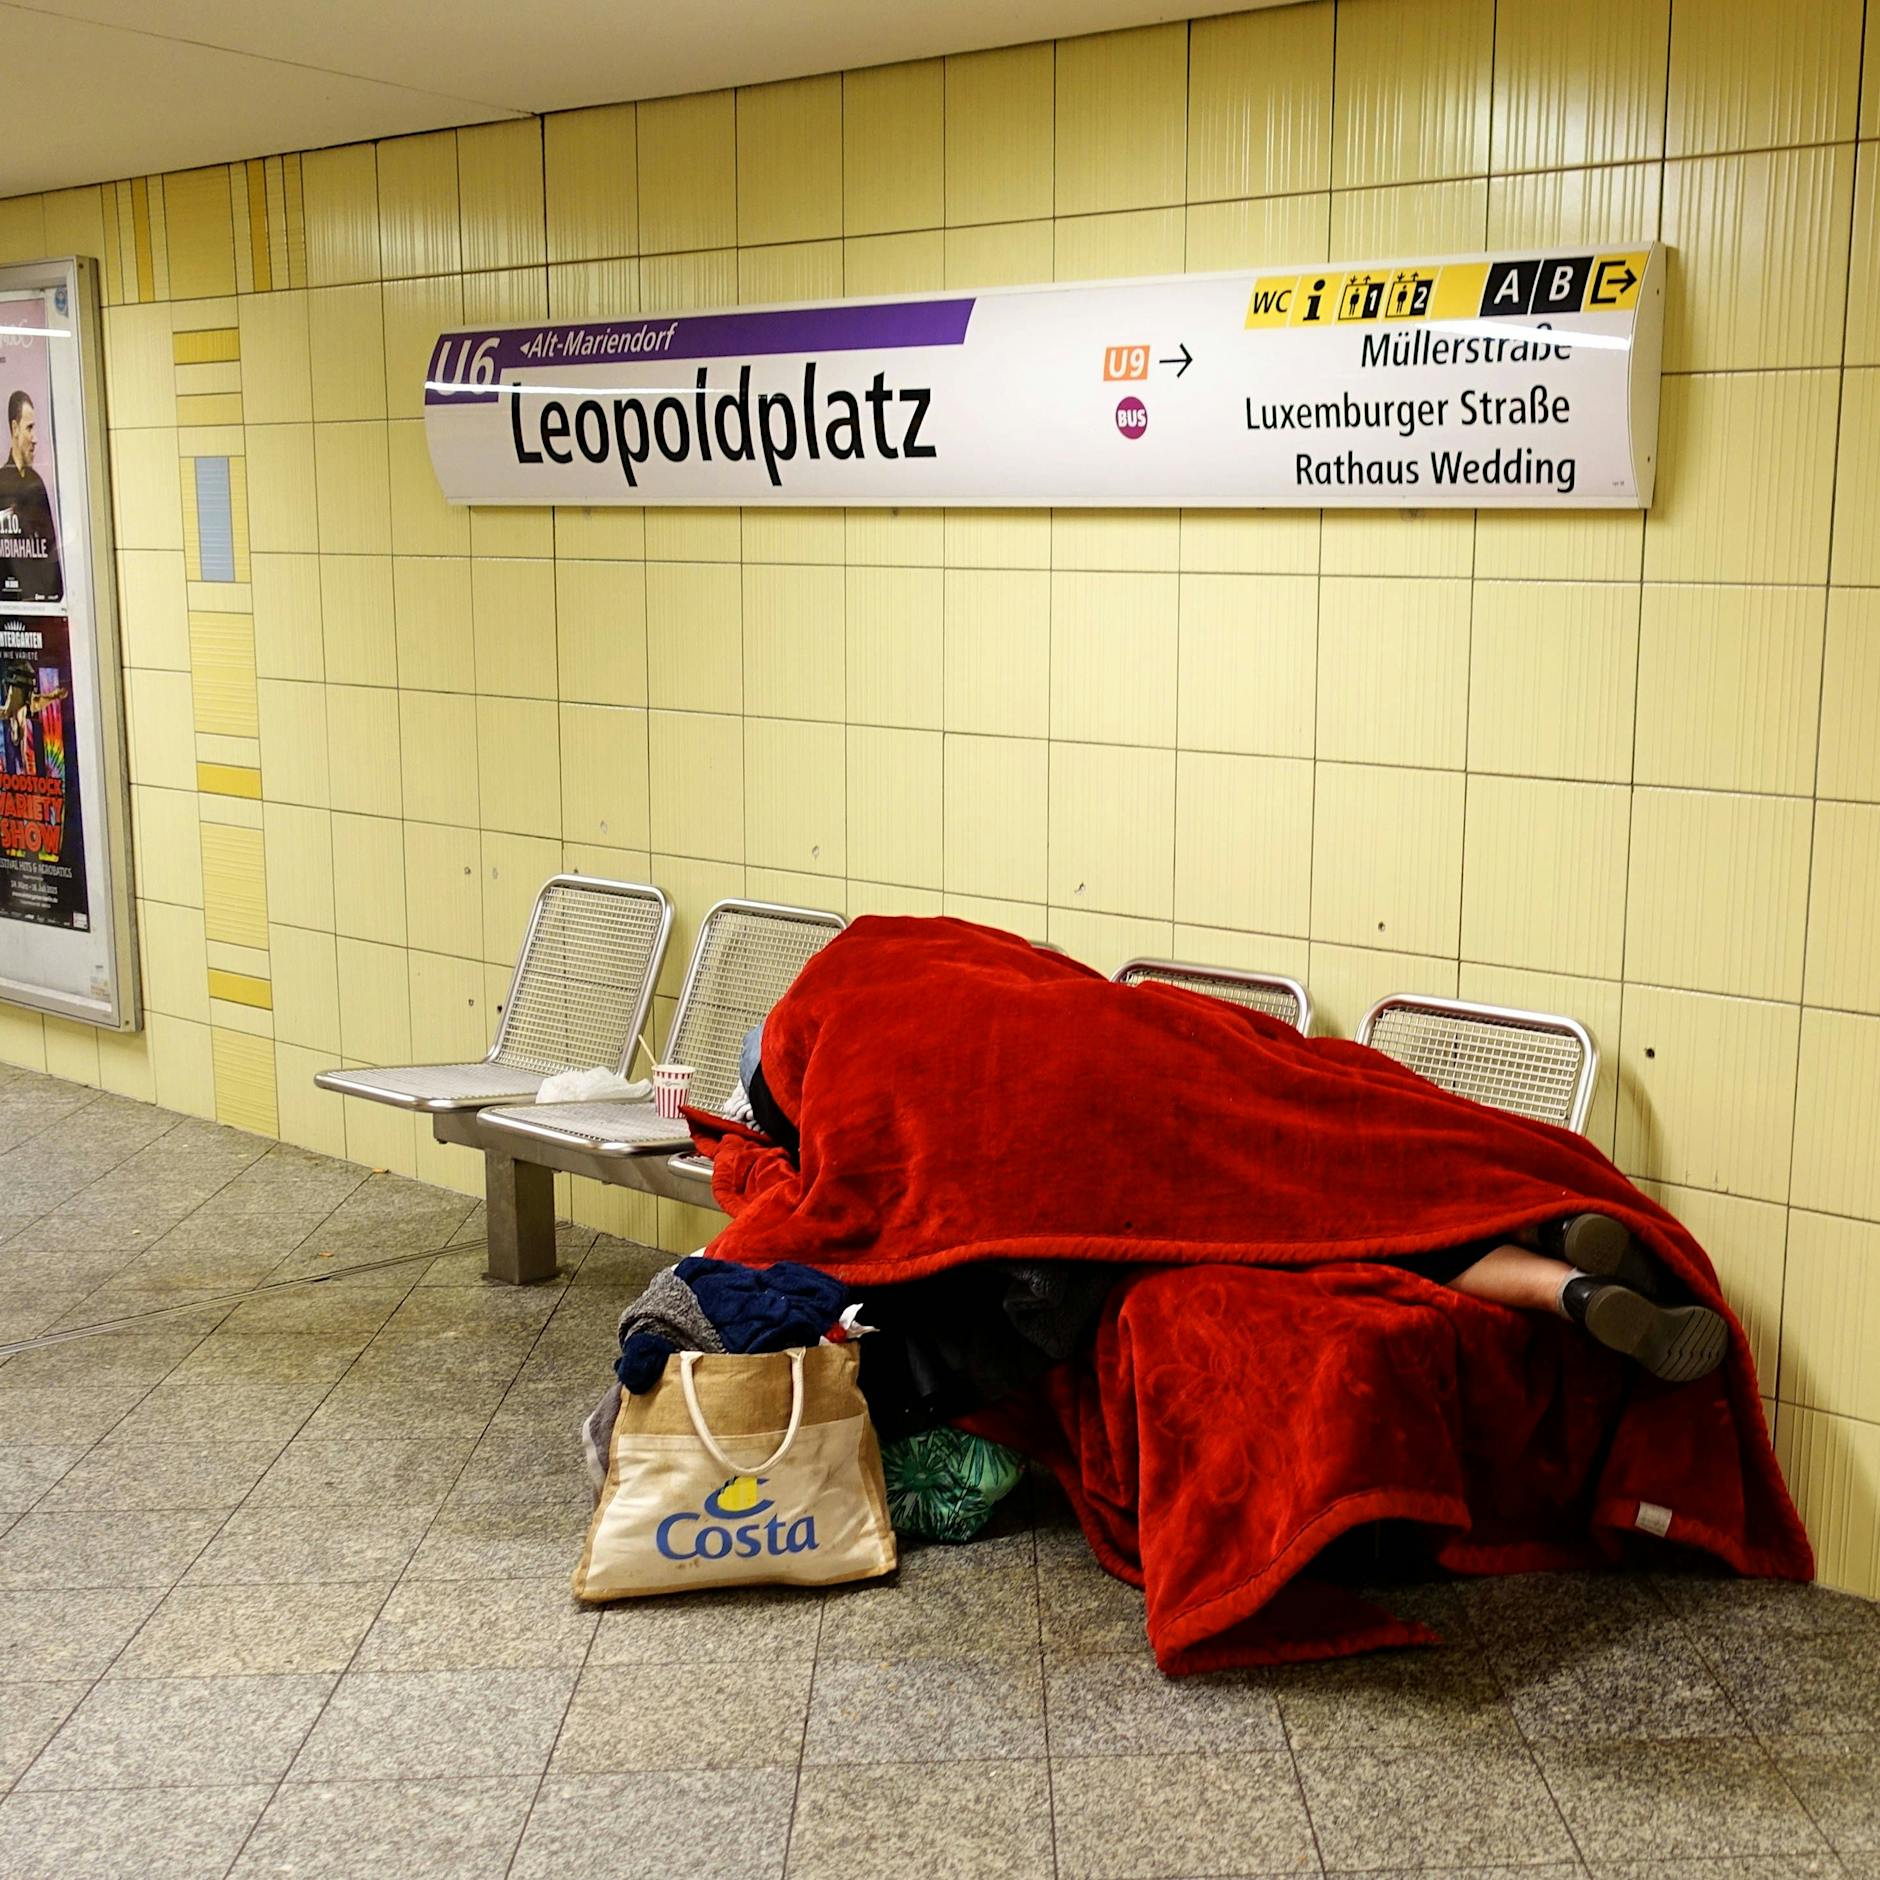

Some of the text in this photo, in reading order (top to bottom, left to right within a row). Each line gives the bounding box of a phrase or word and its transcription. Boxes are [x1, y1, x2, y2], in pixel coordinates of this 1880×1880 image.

[1252, 289, 1292, 314] WC
[1369, 289, 1379, 312] 1
[1413, 286, 1428, 310] 2
[1493, 268, 1520, 305] A
[1549, 265, 1575, 302] B
[526, 322, 679, 359] Alt-Mariendorf
[1109, 348, 1146, 379] U9
[1360, 322, 1573, 368] Müllerstraße
[434, 337, 500, 396] U6
[511, 362, 938, 488] Leopoldplatz
[1117, 408, 1146, 428] BUS
[1245, 384, 1571, 437] Luxemburger Straße
[1295, 447, 1577, 494] Rathaus Wedding
[1, 818, 61, 854] SHOW
[656, 1512, 820, 1561] Costa
